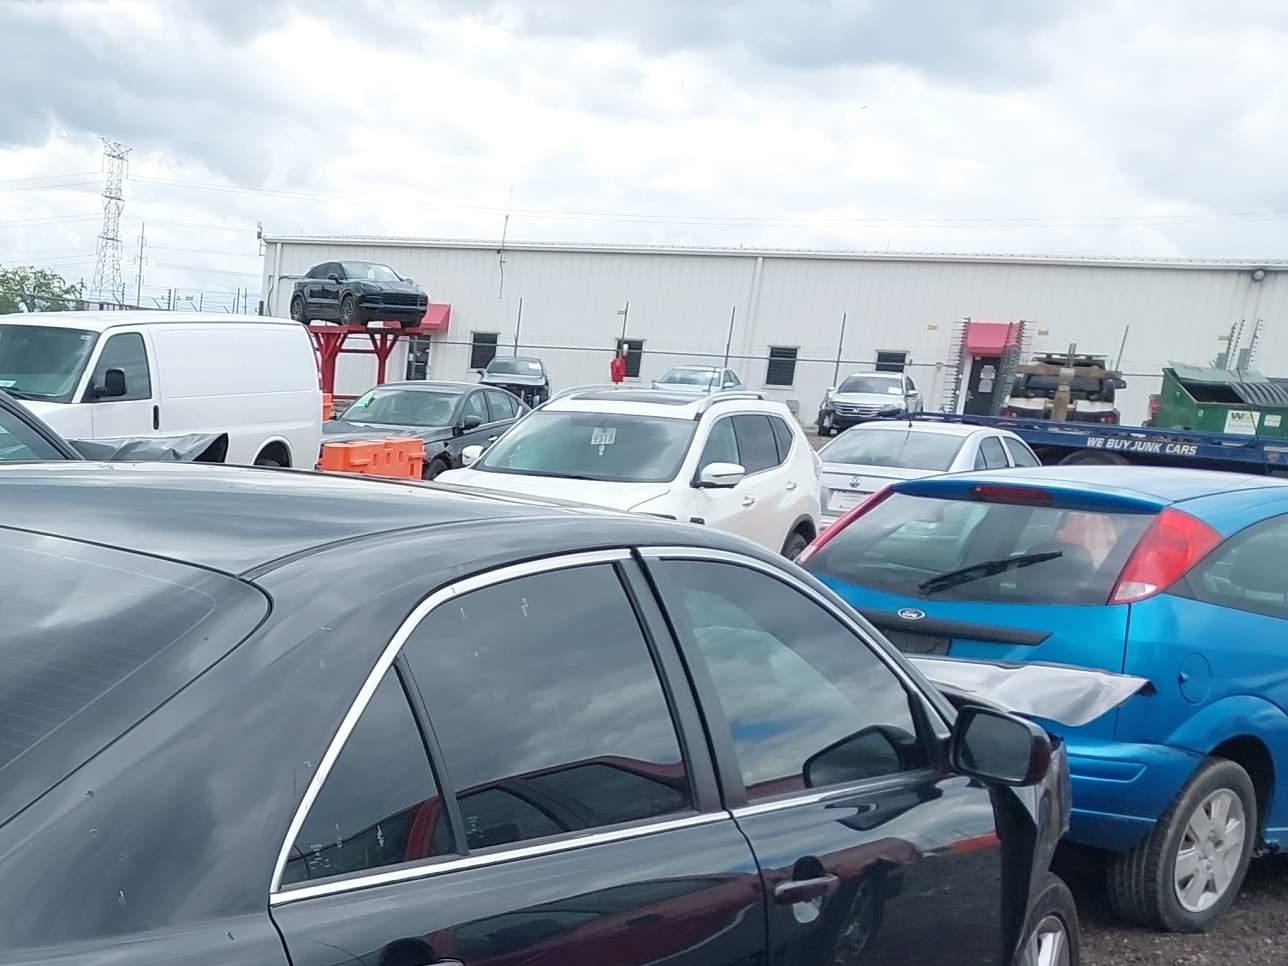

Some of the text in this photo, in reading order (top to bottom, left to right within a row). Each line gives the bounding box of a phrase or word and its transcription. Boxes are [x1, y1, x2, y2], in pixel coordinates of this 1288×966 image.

[1086, 437, 1198, 456] WE BUY JUNK CARS
